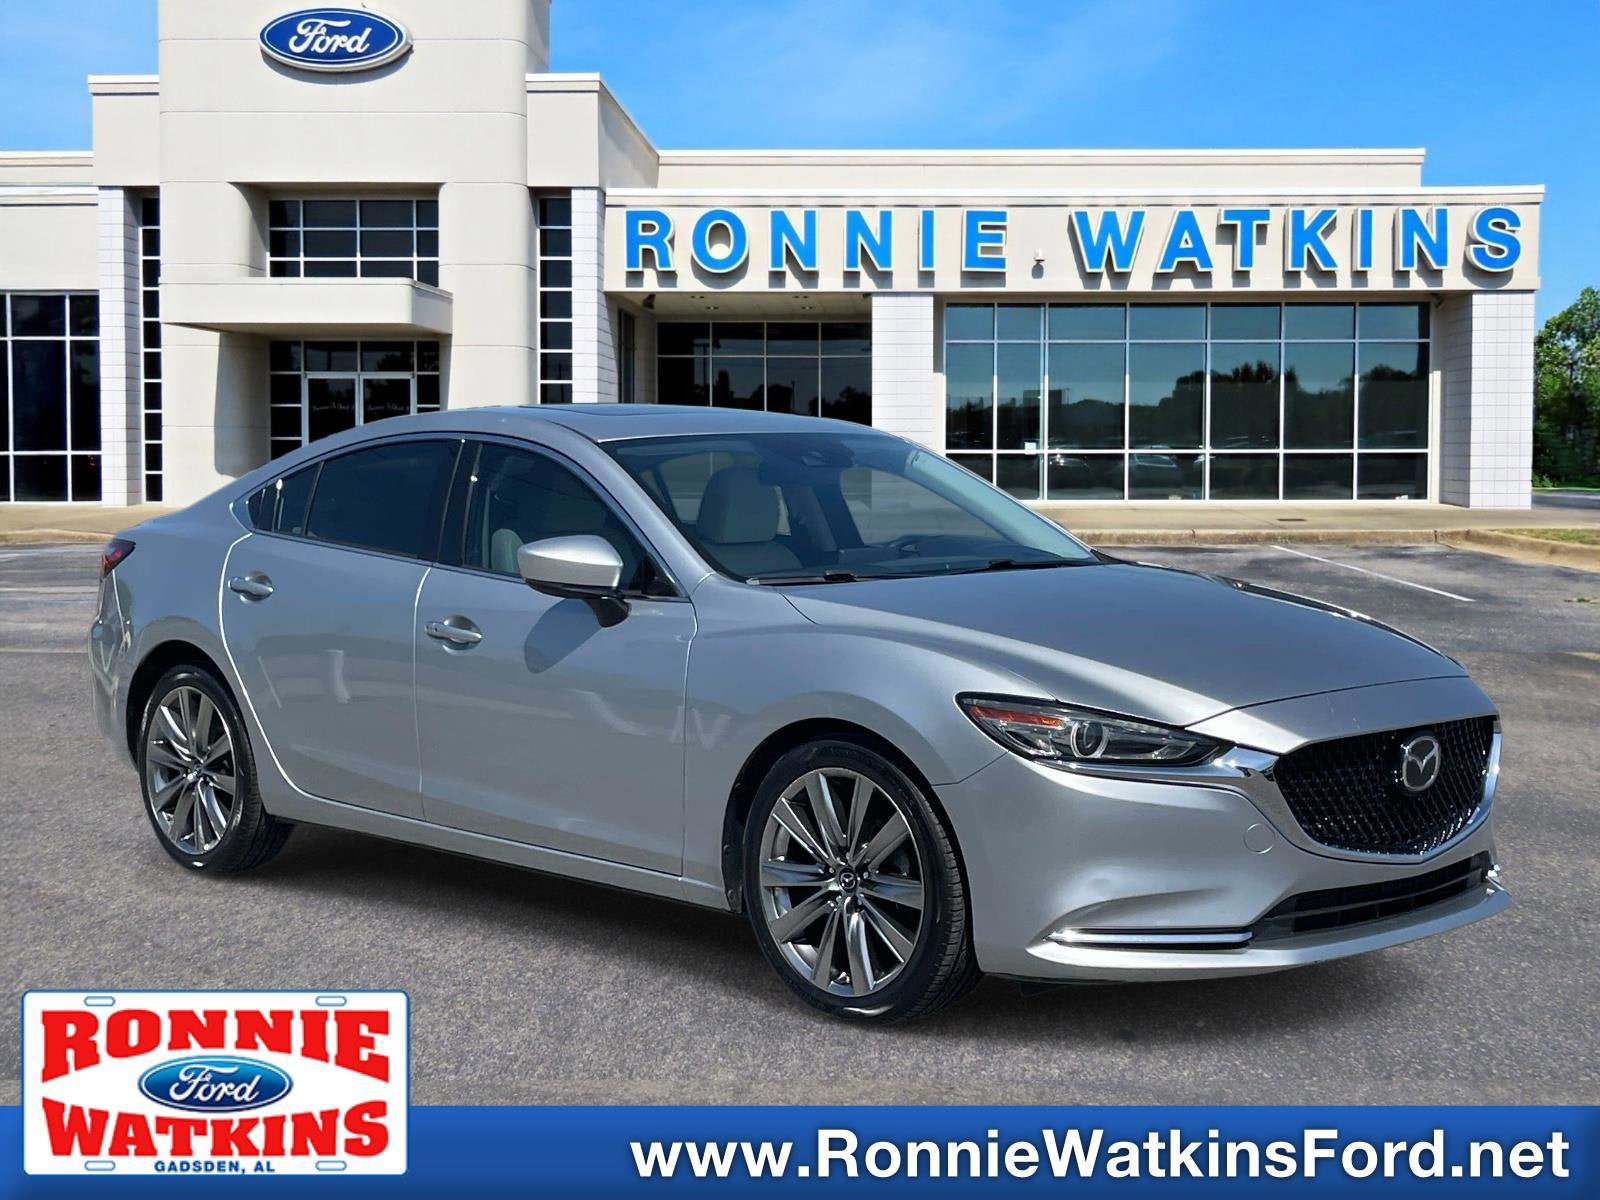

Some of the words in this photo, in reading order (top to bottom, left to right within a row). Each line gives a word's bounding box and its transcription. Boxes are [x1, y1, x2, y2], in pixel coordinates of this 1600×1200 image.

[288, 18, 372, 54] Ford
[625, 208, 1008, 273] RONNIE
[1068, 206, 1522, 272] WATKINS
